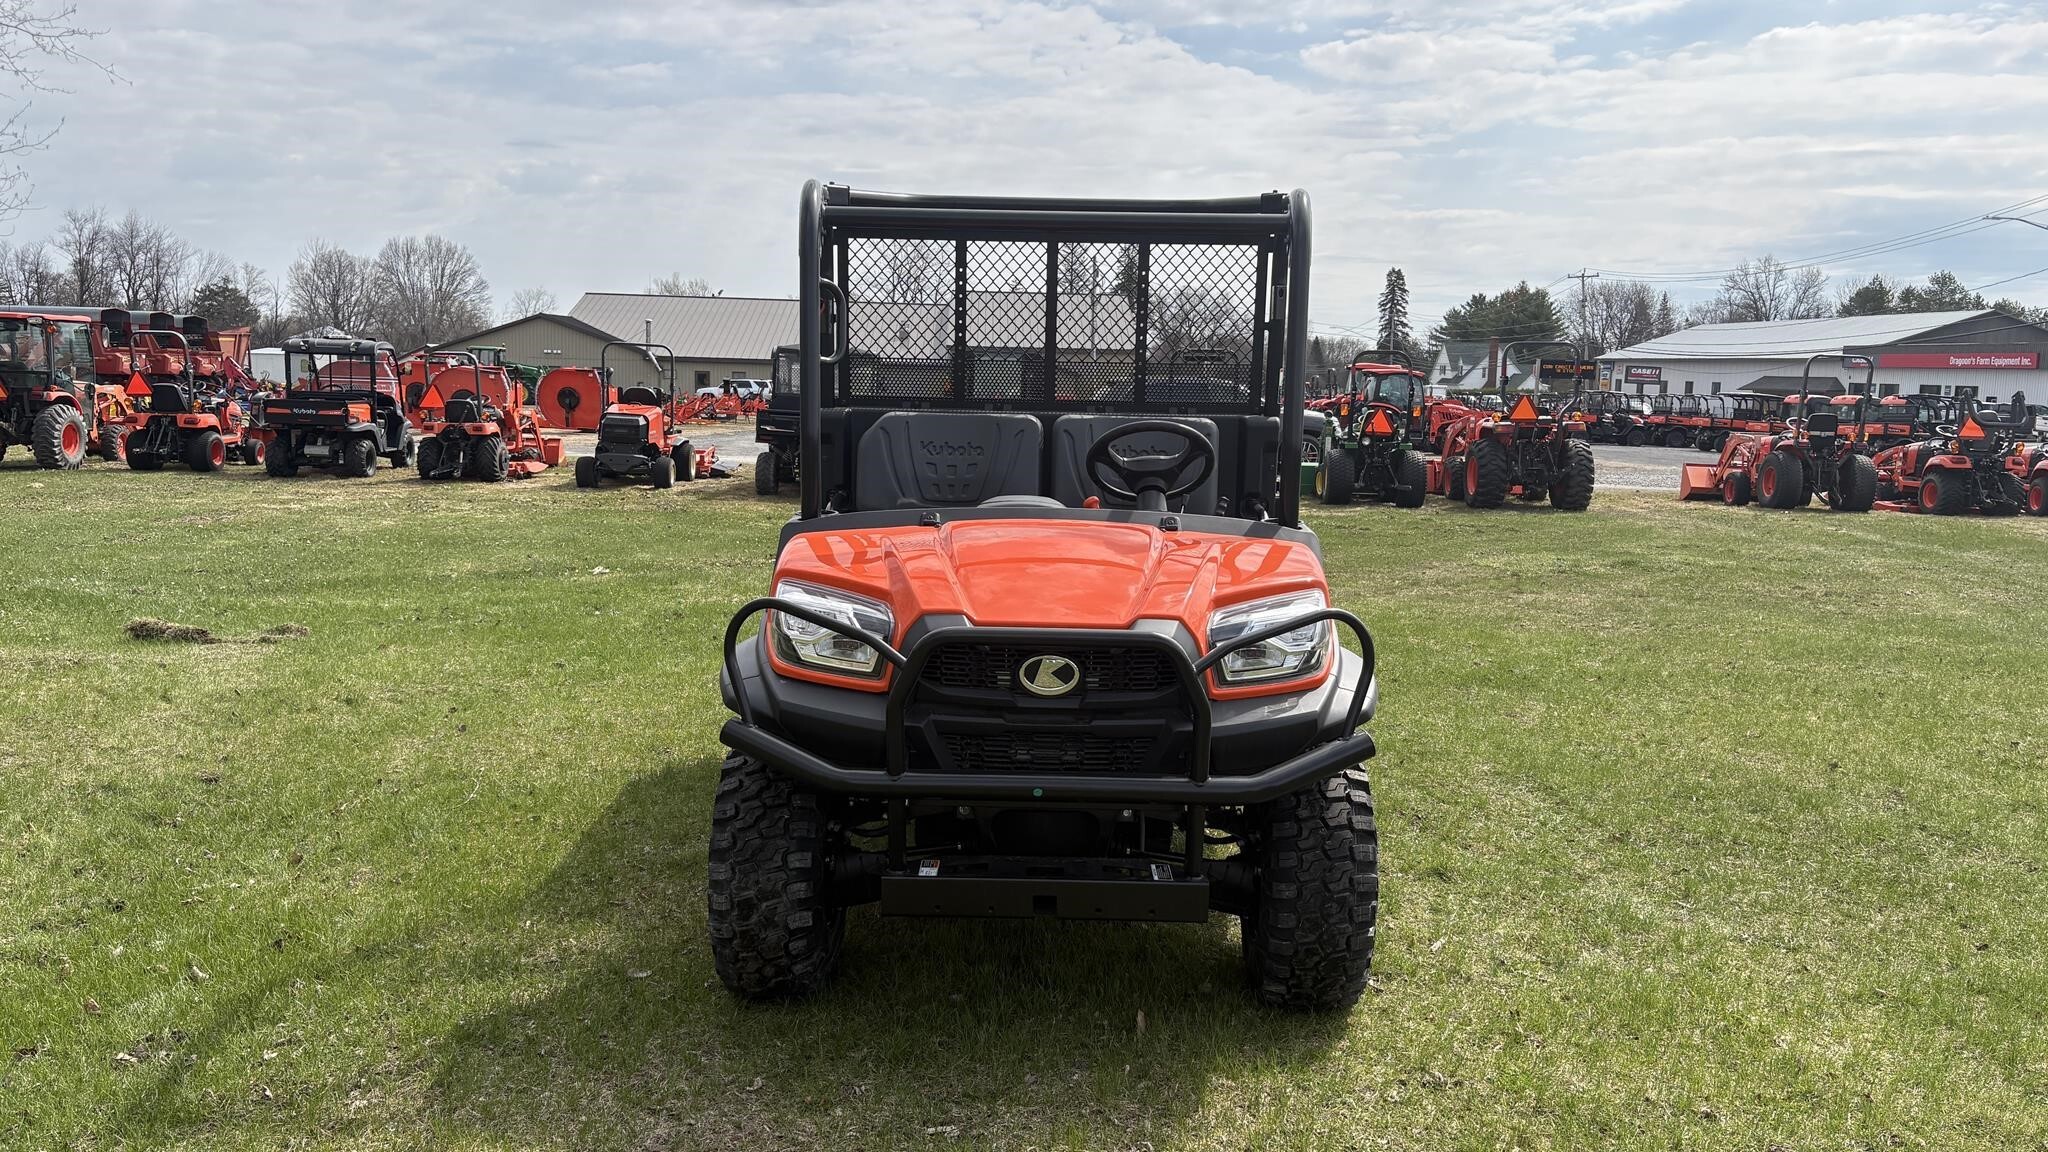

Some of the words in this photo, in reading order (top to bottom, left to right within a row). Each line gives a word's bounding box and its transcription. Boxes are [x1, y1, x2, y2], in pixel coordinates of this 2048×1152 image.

[1976, 356, 1990, 365] Farm
[1991, 356, 2020, 367] Equipment
[2021, 356, 2032, 365] Inc.
[293, 407, 316, 415] Kubota
[920, 440, 984, 457] Kubota
